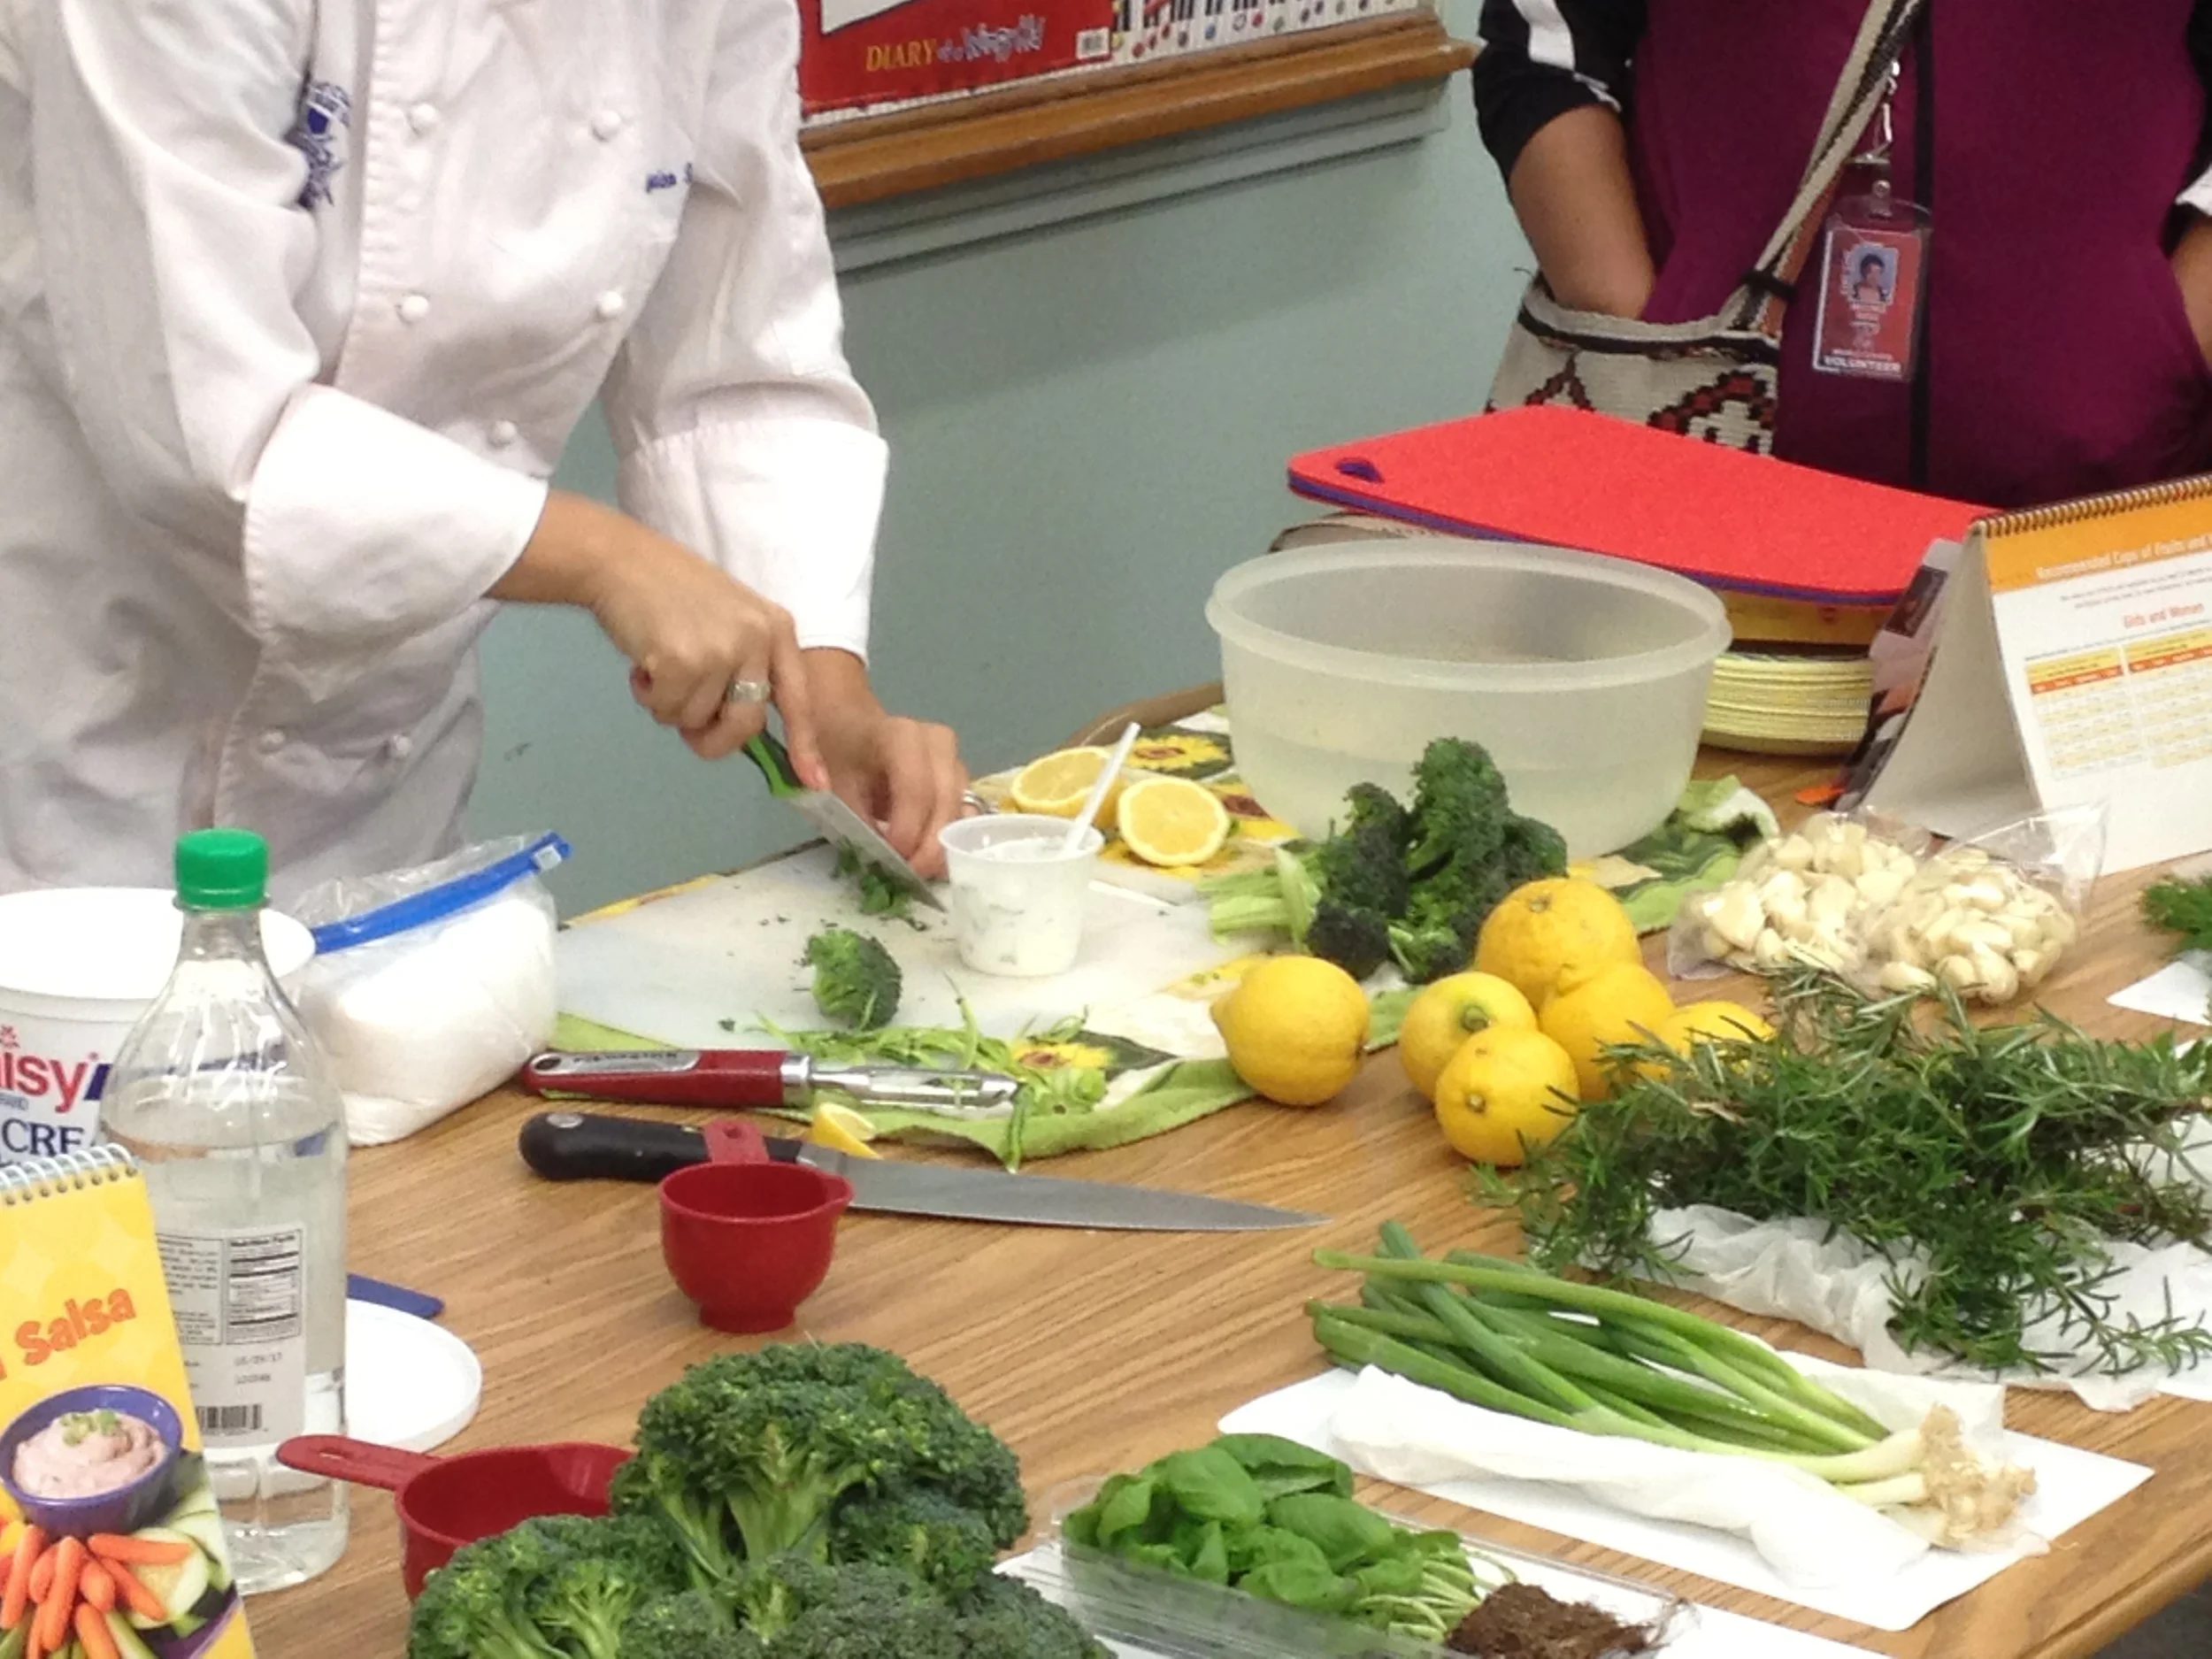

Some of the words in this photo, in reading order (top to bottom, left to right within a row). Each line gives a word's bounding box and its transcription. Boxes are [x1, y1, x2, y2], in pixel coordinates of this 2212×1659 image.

[866, 39, 937, 72] DIARY
[1824, 356, 1901, 372] VOLUNTEER
[0, 1051, 88, 1113] isy
[2, 1118, 96, 1157] CRE
[14, 1288, 137, 1366] Salsa
